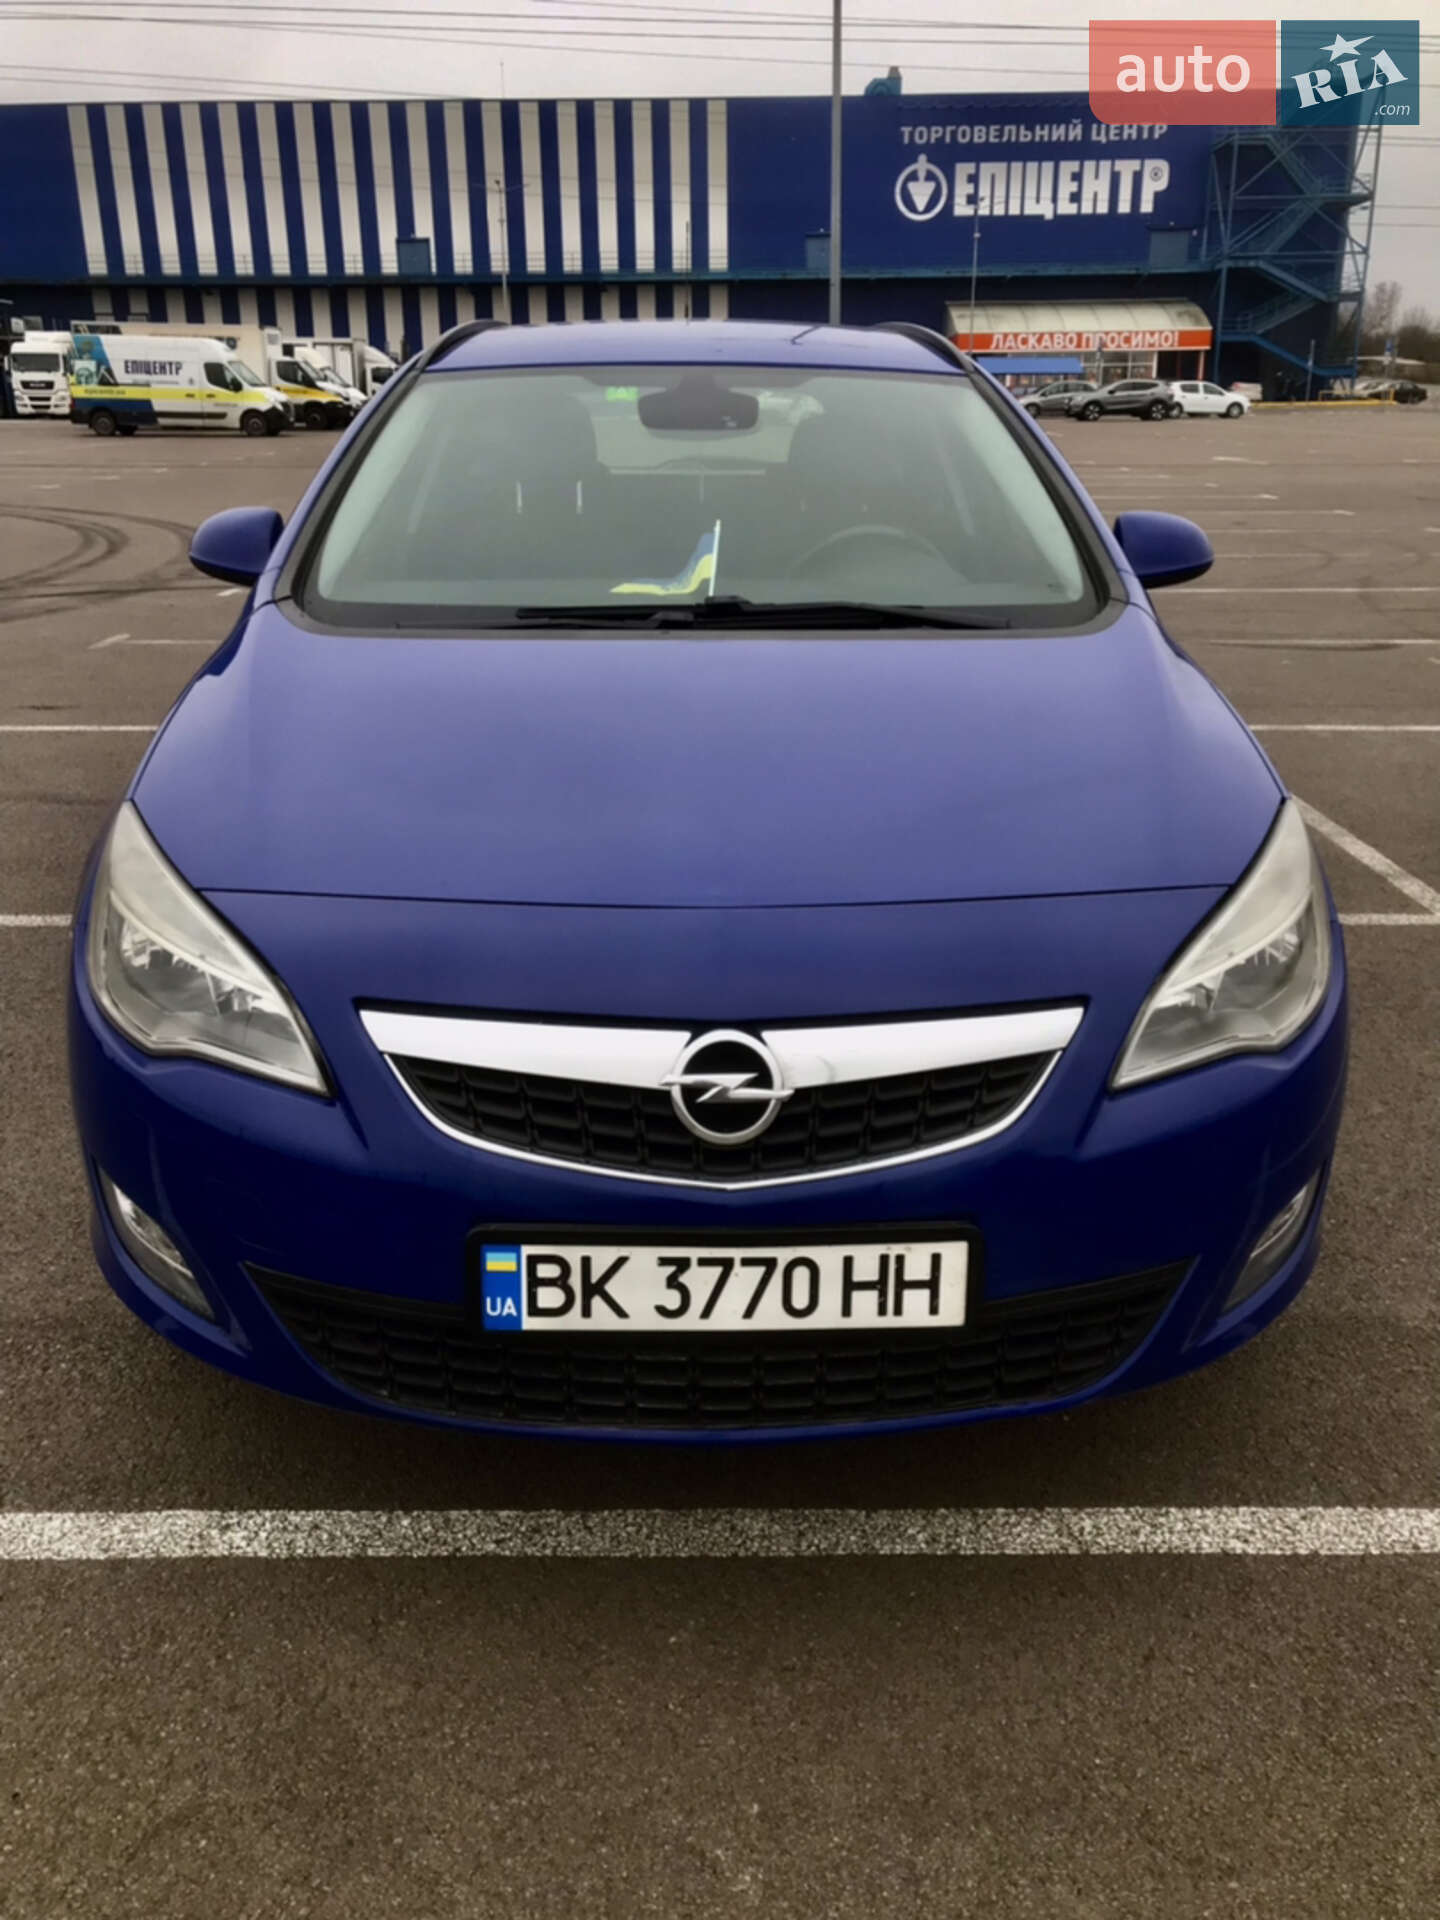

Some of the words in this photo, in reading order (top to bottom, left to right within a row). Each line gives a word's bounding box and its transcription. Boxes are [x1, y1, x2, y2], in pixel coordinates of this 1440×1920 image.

[900, 119, 1083, 145] ТОРГОВЕЛЬНИЙ
[1091, 122, 1169, 144] ЦЕНТР
[990, 332, 1077, 350] ЛАСКАВО
[1081, 331, 1180, 349] ПРОСИМО!
[124, 359, 183, 376] ЕПІЦЕНТР
[526, 1253, 631, 1319] BK
[654, 1256, 820, 1320] 3770
[841, 1252, 942, 1319] HH
[486, 1297, 517, 1317] UA
